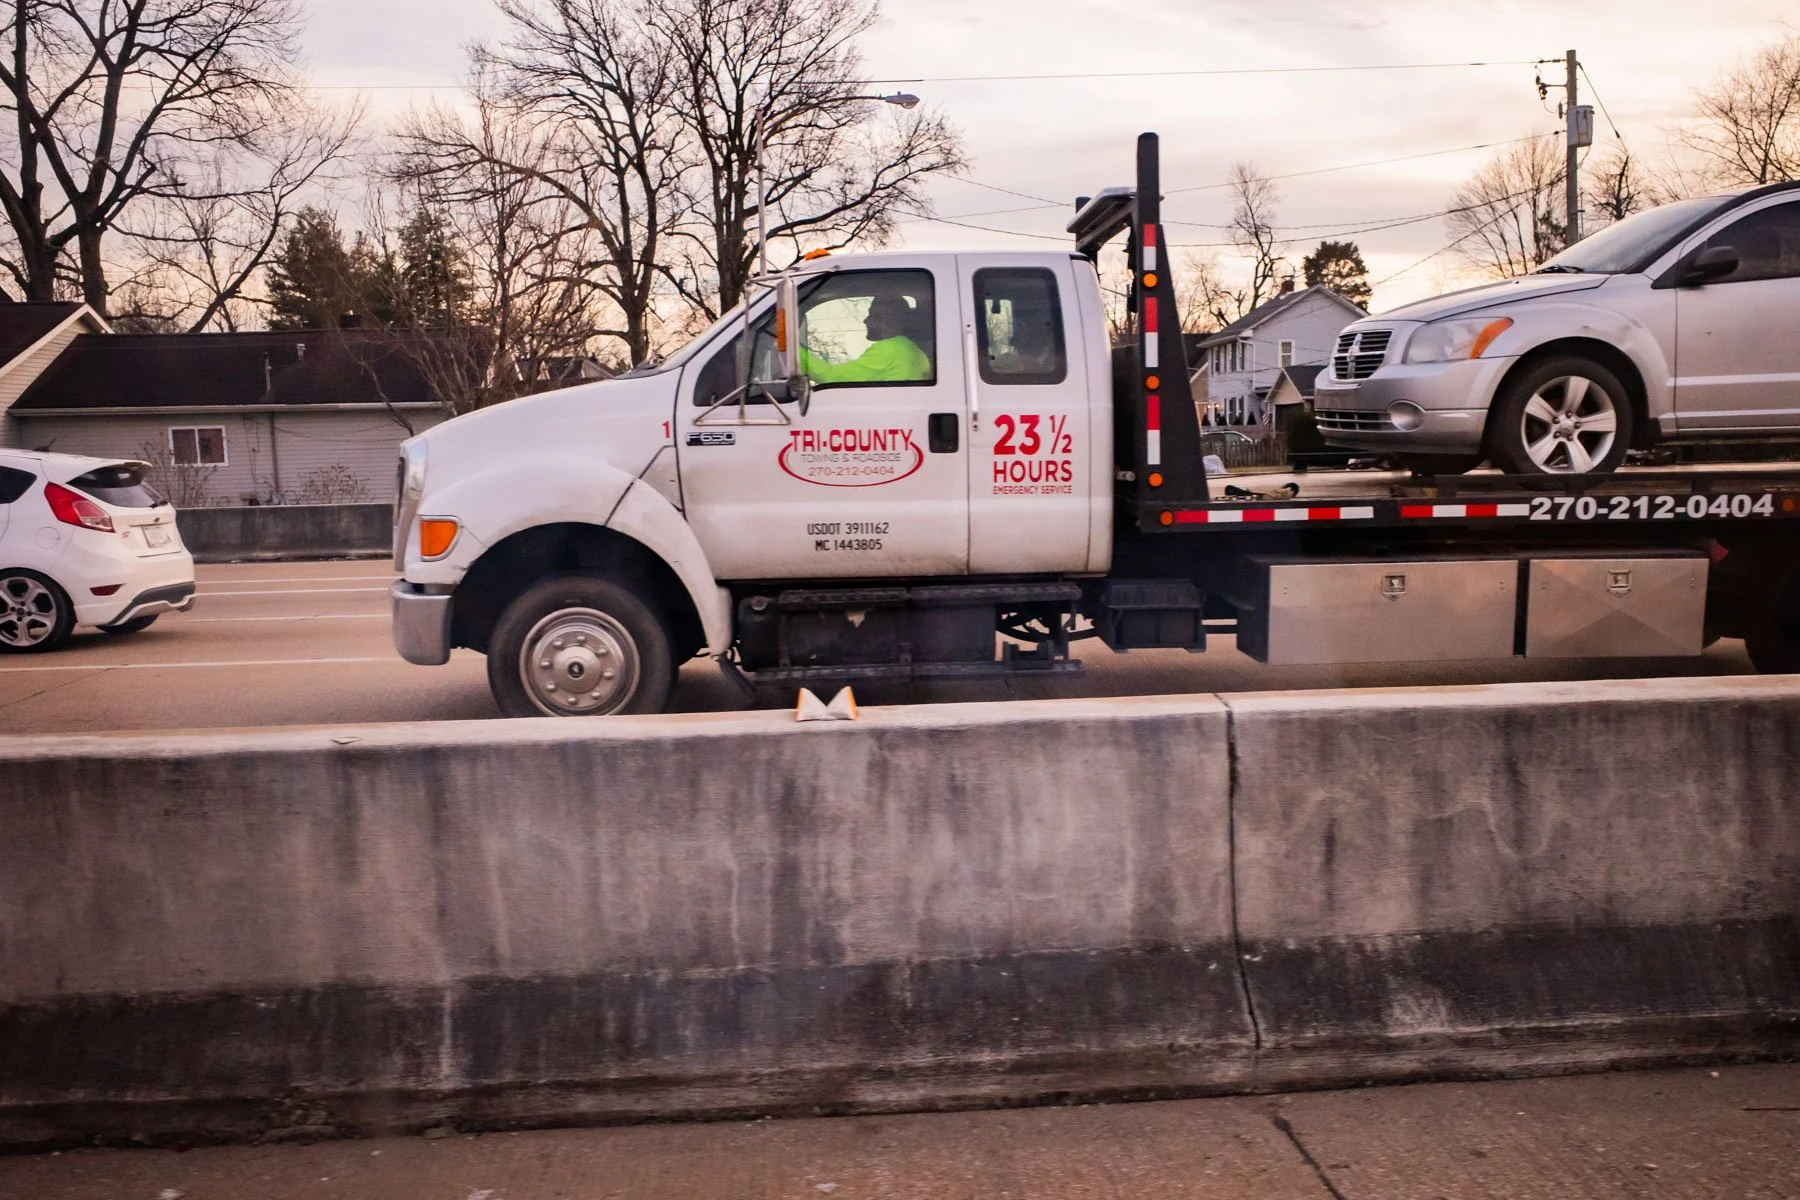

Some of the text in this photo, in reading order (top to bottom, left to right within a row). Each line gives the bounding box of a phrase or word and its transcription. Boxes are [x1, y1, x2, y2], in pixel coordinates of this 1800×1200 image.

[662, 420, 670, 438] 1
[994, 414, 1041, 455] 23
[801, 454, 839, 462] TOWING
[853, 453, 901, 462] ROADSIDE
[808, 466, 894, 476] 270-212-0404
[994, 460, 1072, 483] HOURS
[993, 485, 1072, 495] EMERGENCY SERVICE
[1530, 494, 1774, 520] 270-212-0404
[807, 522, 889, 535] USDOT 3911162
[815, 539, 883, 551] MC 1443805
